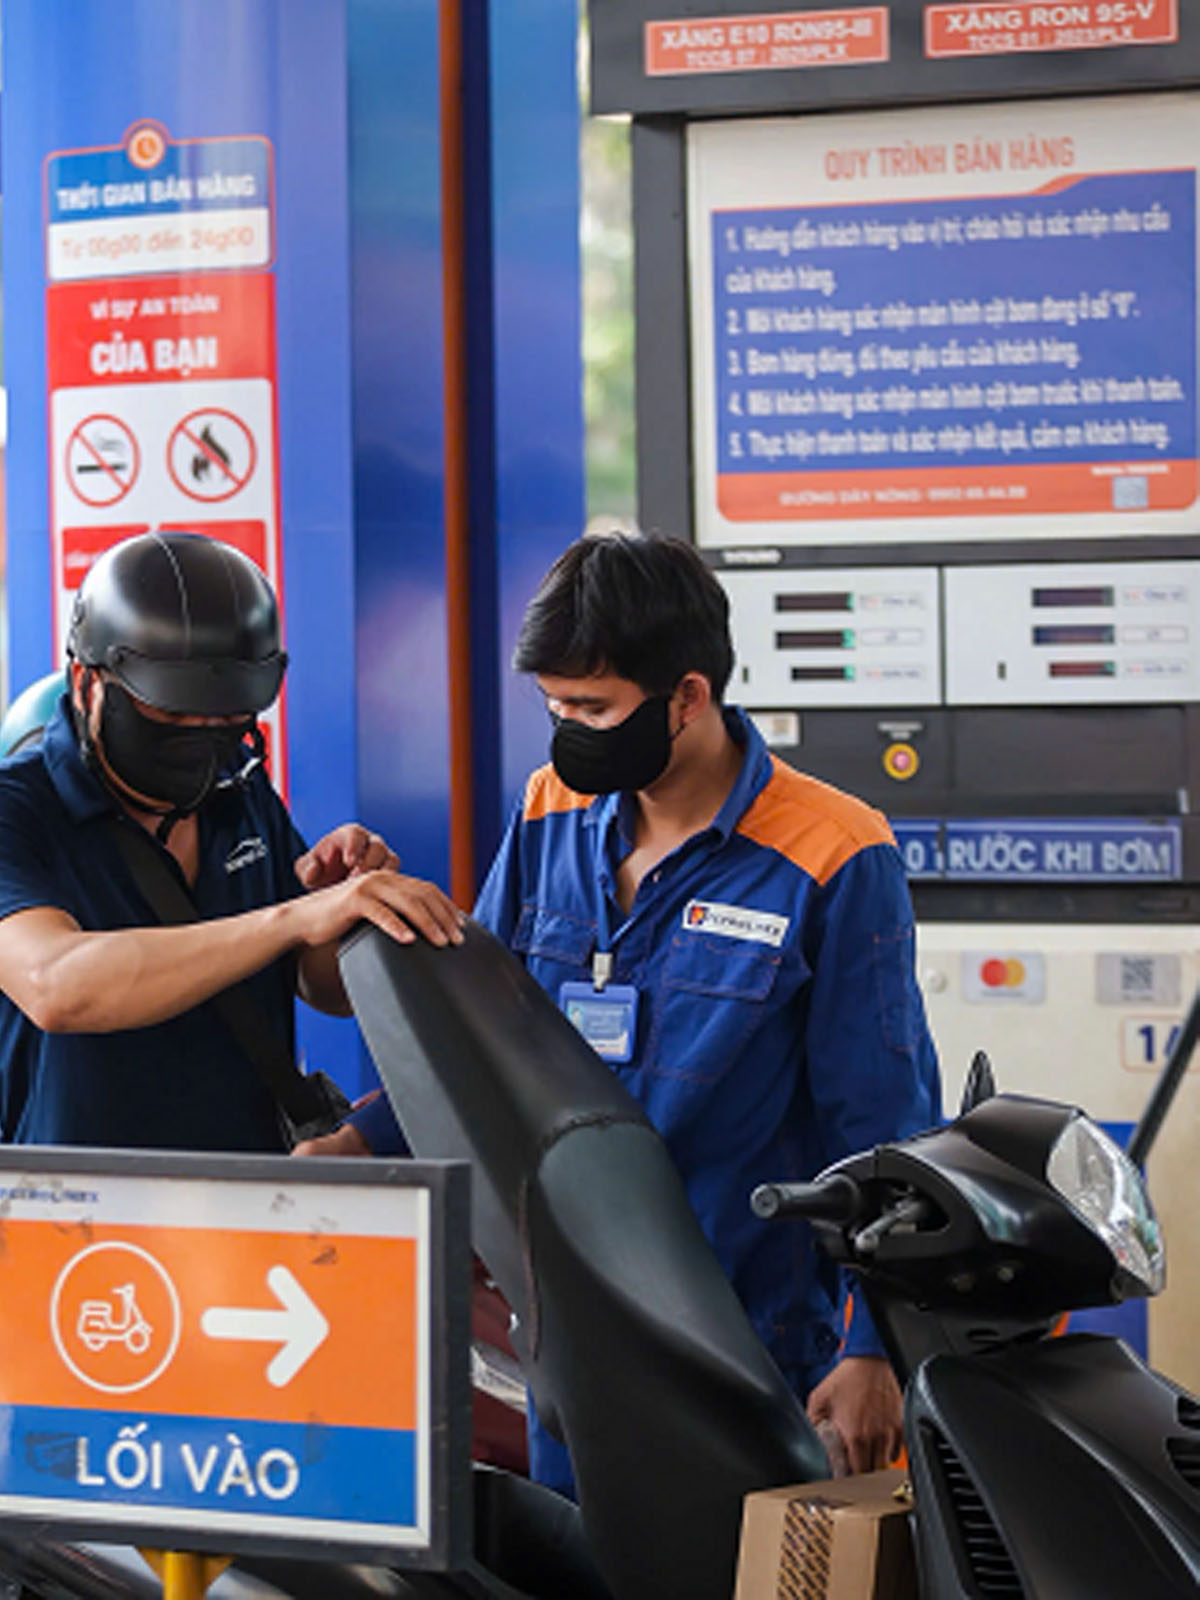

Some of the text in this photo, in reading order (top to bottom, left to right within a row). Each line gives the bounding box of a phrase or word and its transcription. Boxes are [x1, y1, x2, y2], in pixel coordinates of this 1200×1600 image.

[946, 1, 1154, 32] XĂNG RON 95-V
[661, 25, 724, 49] XĂNG
[729, 22, 769, 45] E10
[825, 132, 1075, 181] QUY TRÌNH BÁN HÀNG
[103, 183, 145, 207] GIAN
[152, 175, 192, 203] BÁN
[198, 172, 256, 198] HÀNG
[90, 331, 218, 376] CỦA BẠN
[1045, 841, 1093, 871] KHI
[1101, 837, 1170, 872] BƠM
[76, 1422, 299, 1500] LỐI VÀO
